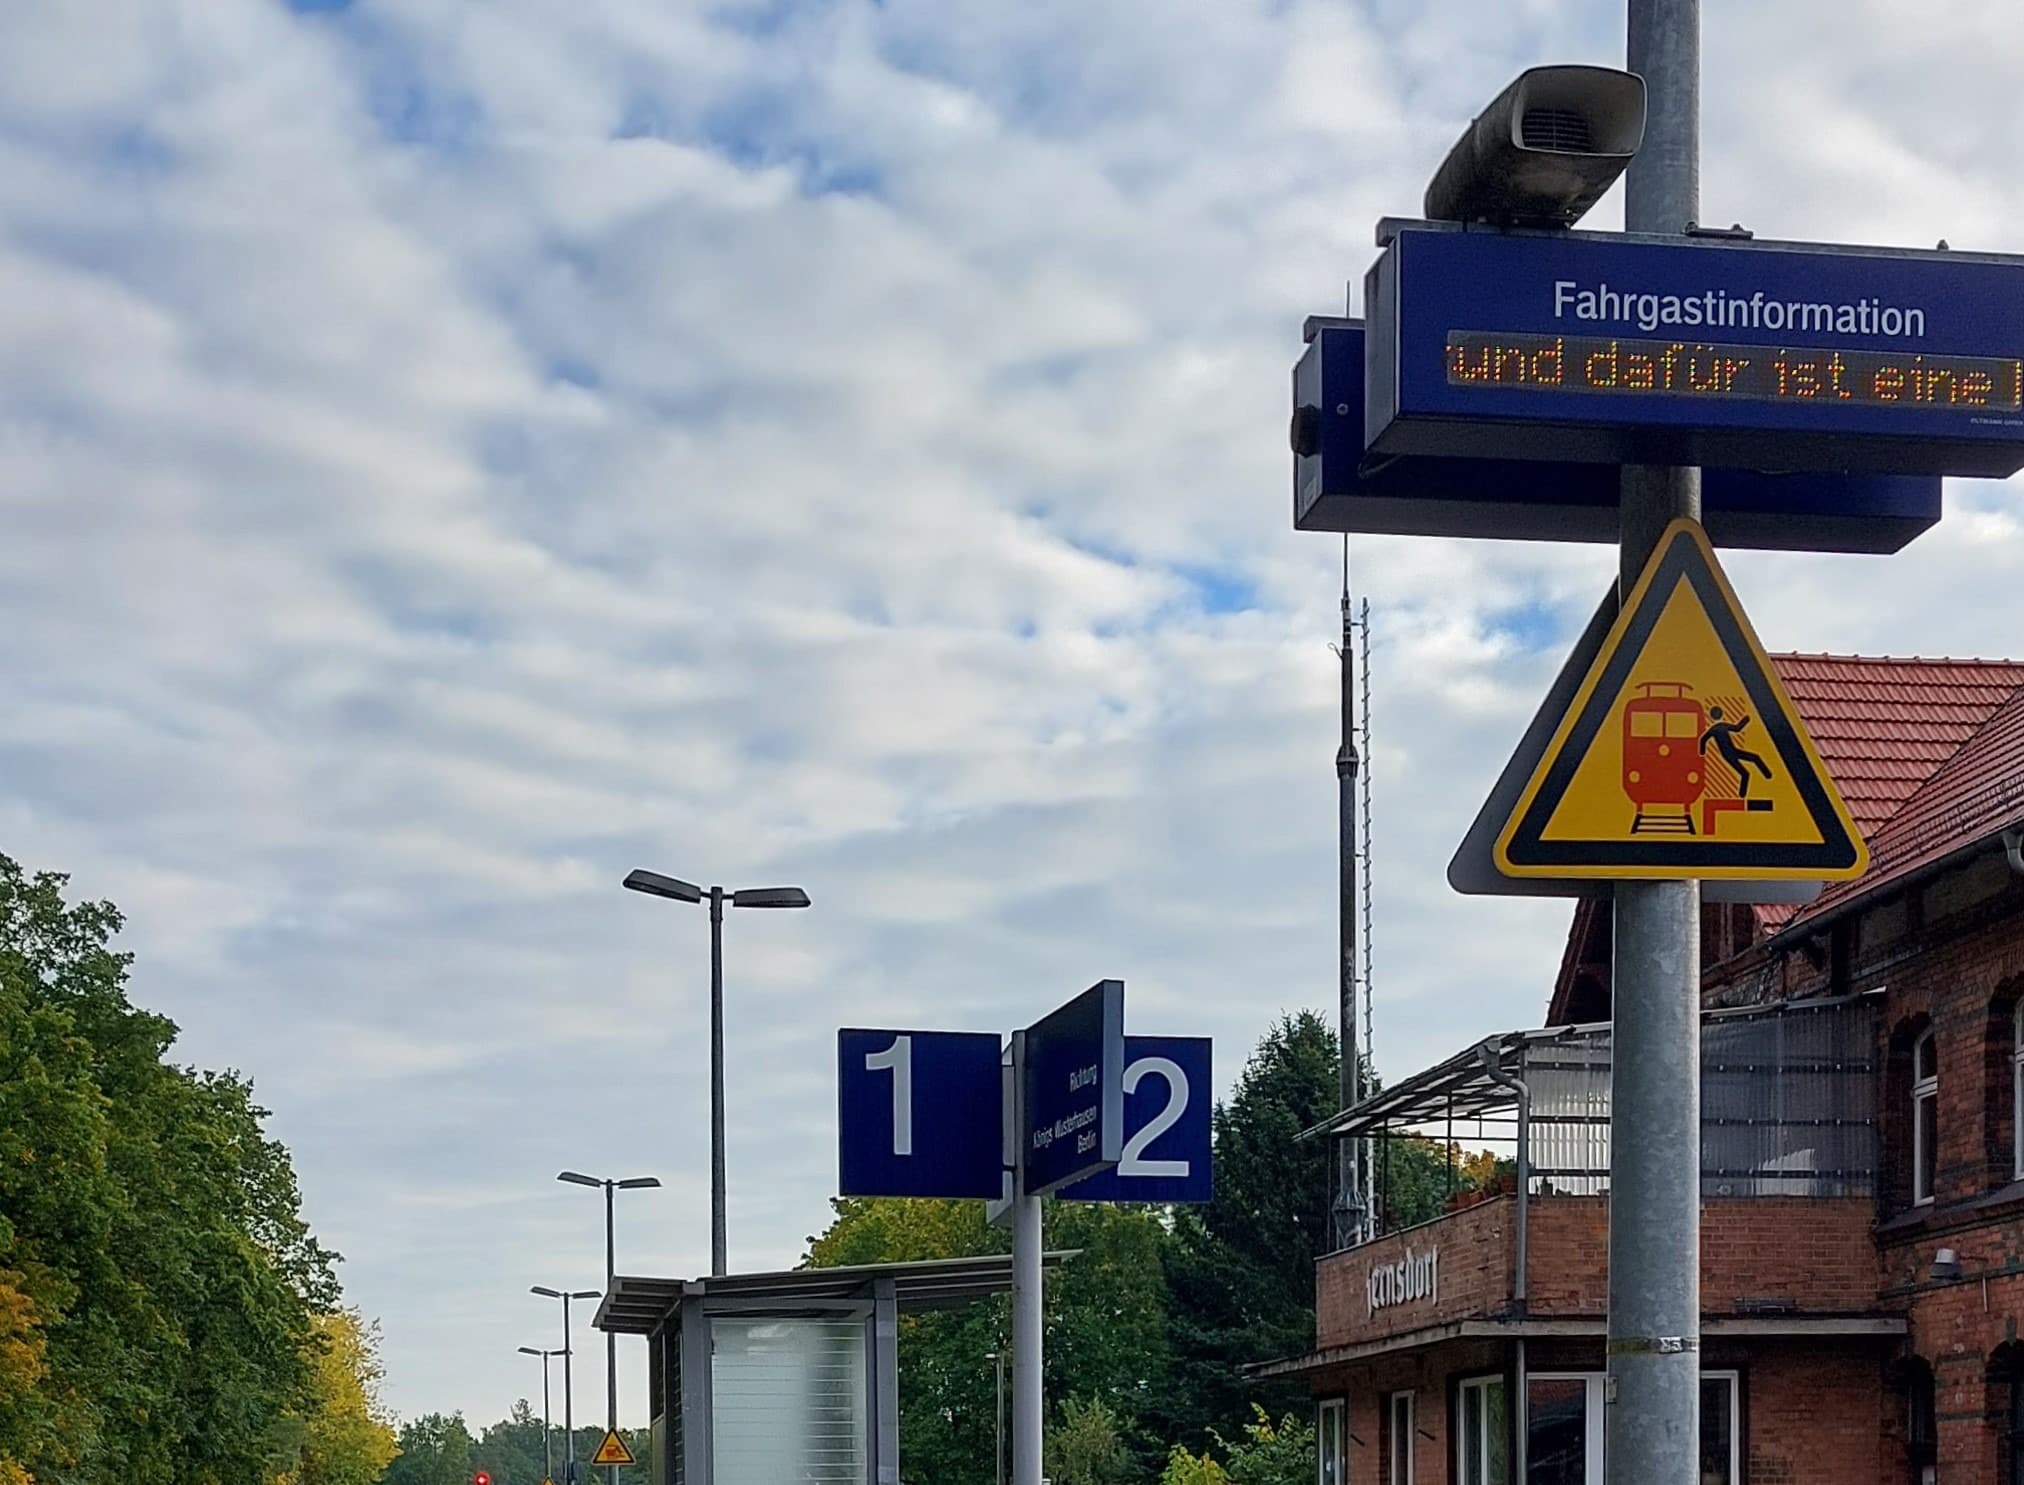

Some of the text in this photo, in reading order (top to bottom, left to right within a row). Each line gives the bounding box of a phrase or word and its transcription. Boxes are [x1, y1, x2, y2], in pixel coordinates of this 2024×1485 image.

[1554, 281, 1925, 337] Fahrgastinformation
[1451, 337, 1563, 385] und
[1586, 341, 1750, 392] dafür
[1773, 349, 1851, 399] ist
[1874, 355, 1992, 404] eine
[865, 1035, 912, 1156] 1
[1069, 1064, 1097, 1093] Richtung
[1117, 1056, 1190, 1177] 2
